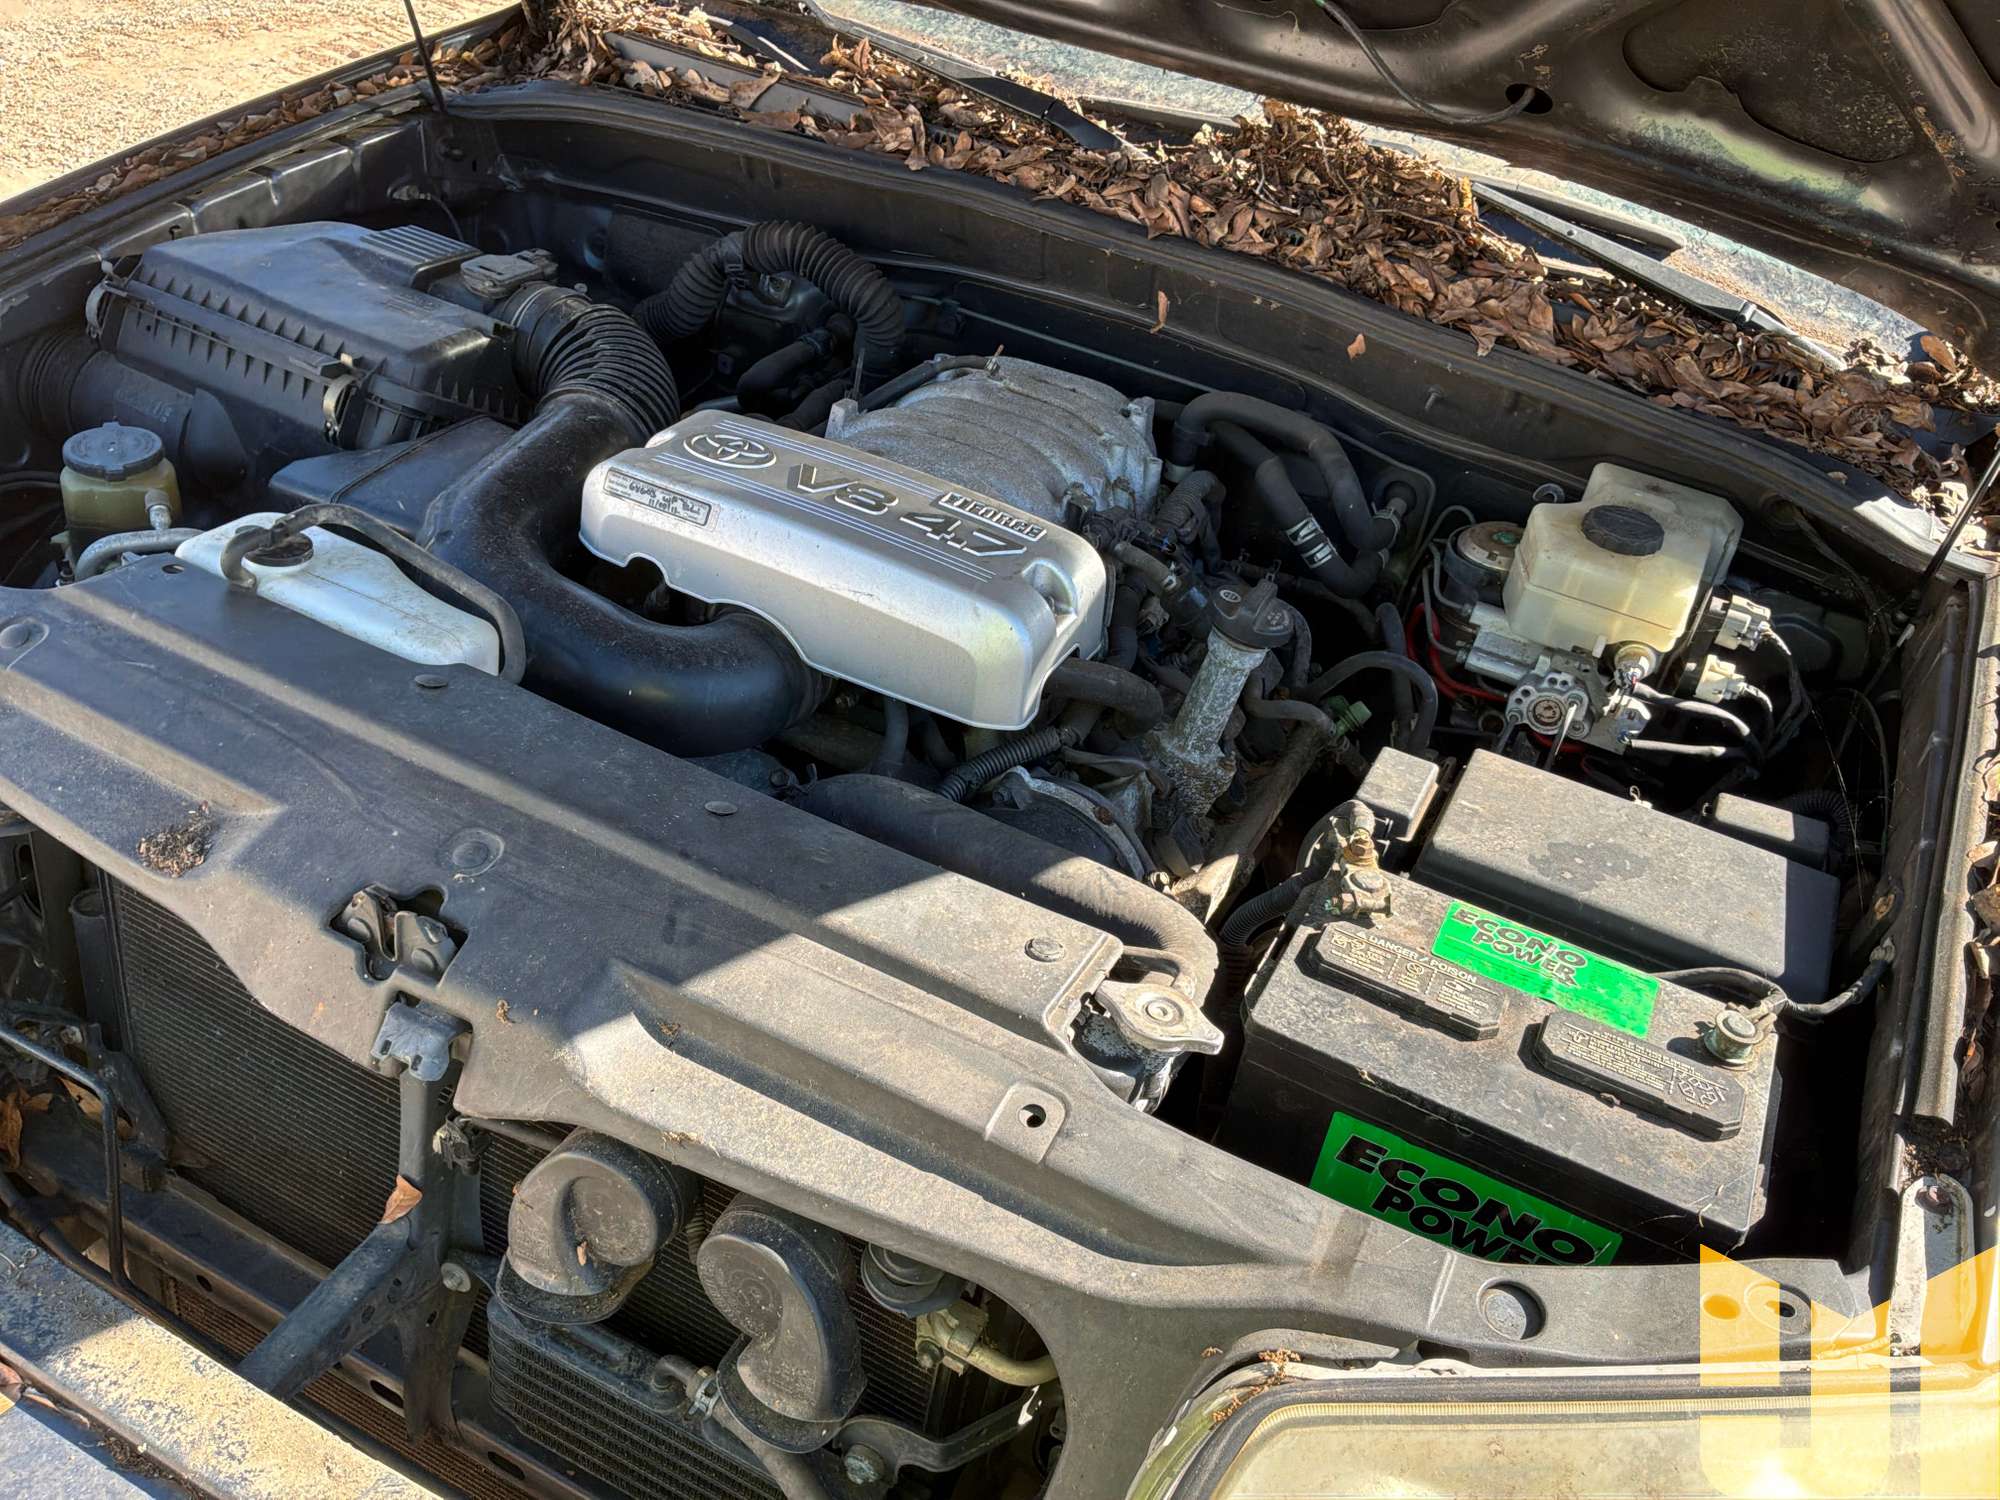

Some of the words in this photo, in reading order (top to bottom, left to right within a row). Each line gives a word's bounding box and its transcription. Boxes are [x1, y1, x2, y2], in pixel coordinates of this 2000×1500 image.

[789, 463, 899, 516] V8
[900, 511, 1027, 557] 4.7
[1369, 934, 1419, 960] DANGER
[1430, 959, 1477, 984] POISON
[1452, 908, 1588, 968] ECONO
[1472, 930, 1578, 986] POWER
[1335, 1134, 1597, 1266] ECONO
